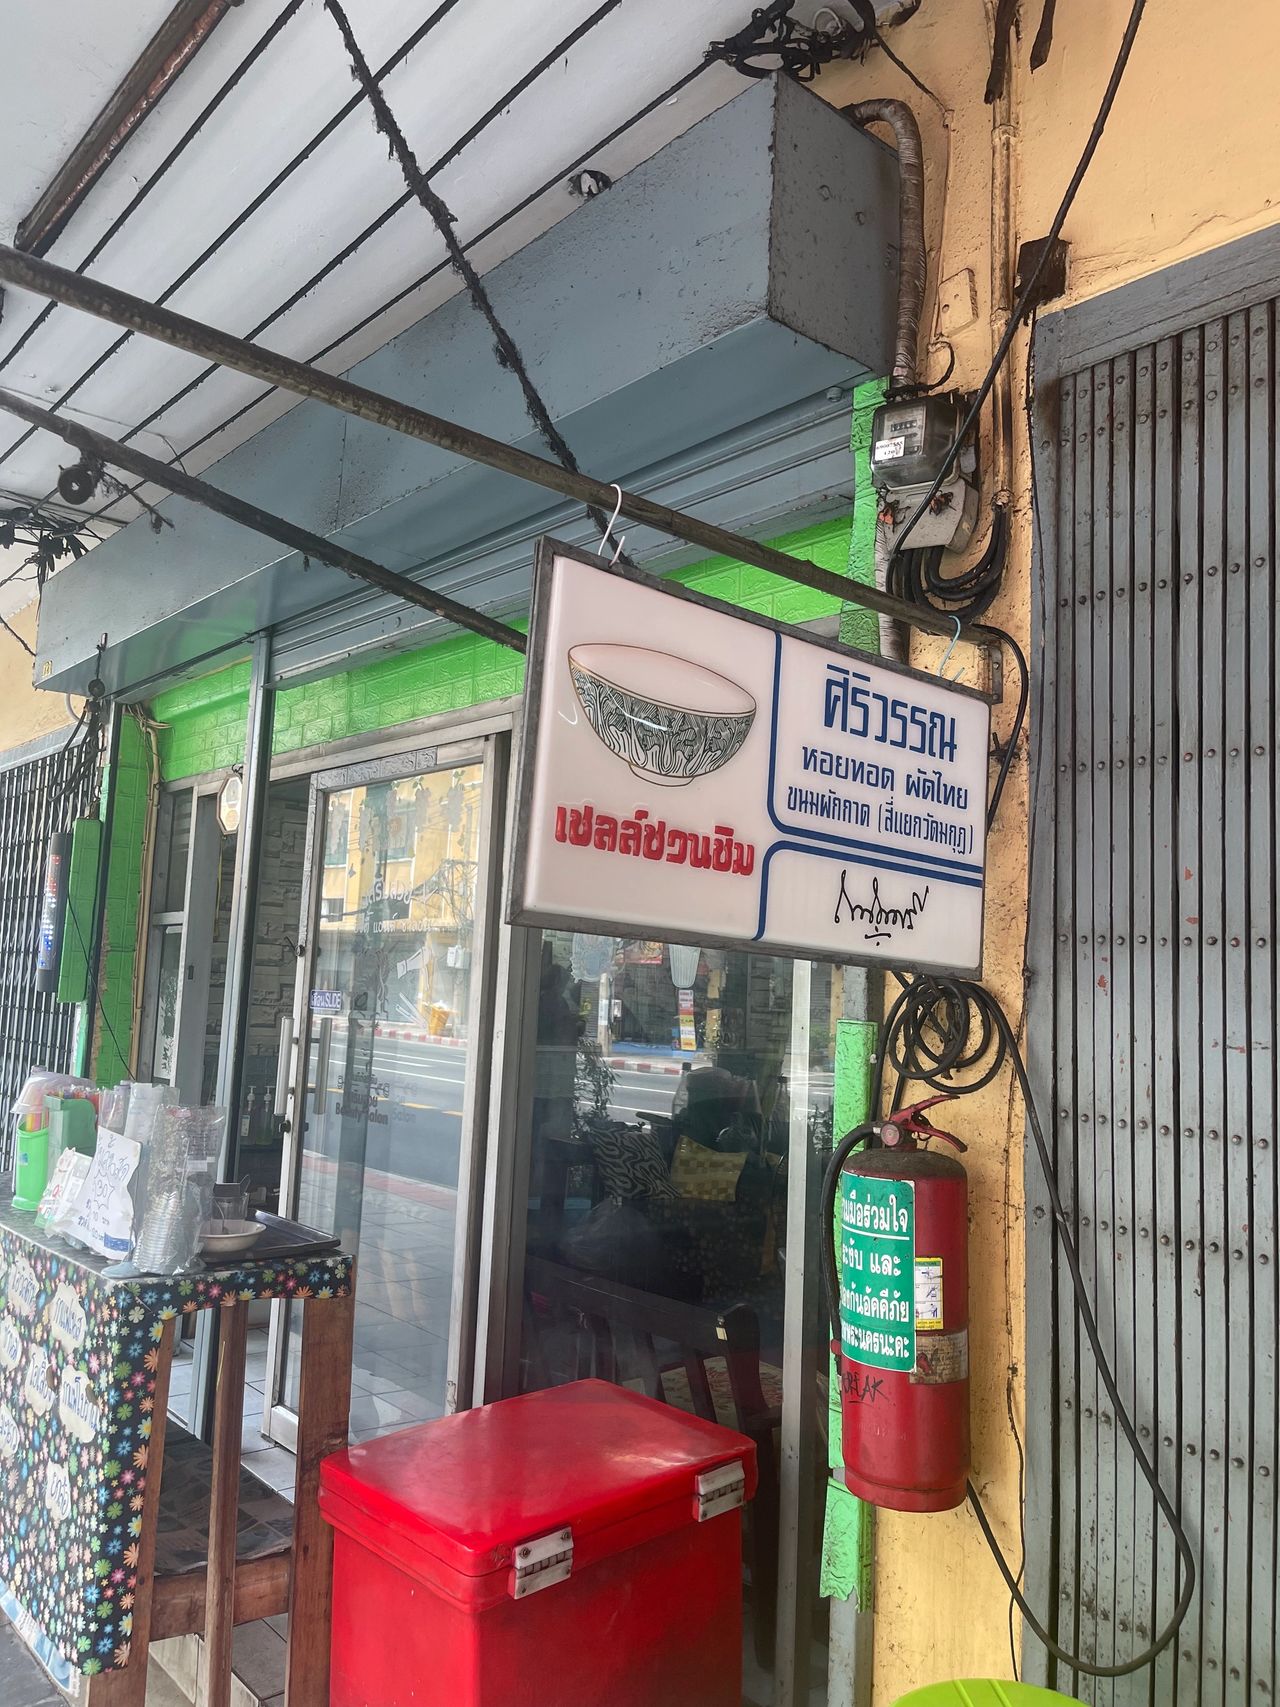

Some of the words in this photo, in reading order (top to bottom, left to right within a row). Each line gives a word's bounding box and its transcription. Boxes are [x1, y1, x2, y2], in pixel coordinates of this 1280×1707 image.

[824, 664, 957, 762] ศิริวรรณ
[787, 786, 870, 827] ขนมผักกาด
[802, 746, 895, 791] หอยทอด
[905, 768, 968, 810] ผัดไทย
[555, 805, 755, 876] เชลล์ชวนชิม
[870, 1252, 901, 1277] และ
